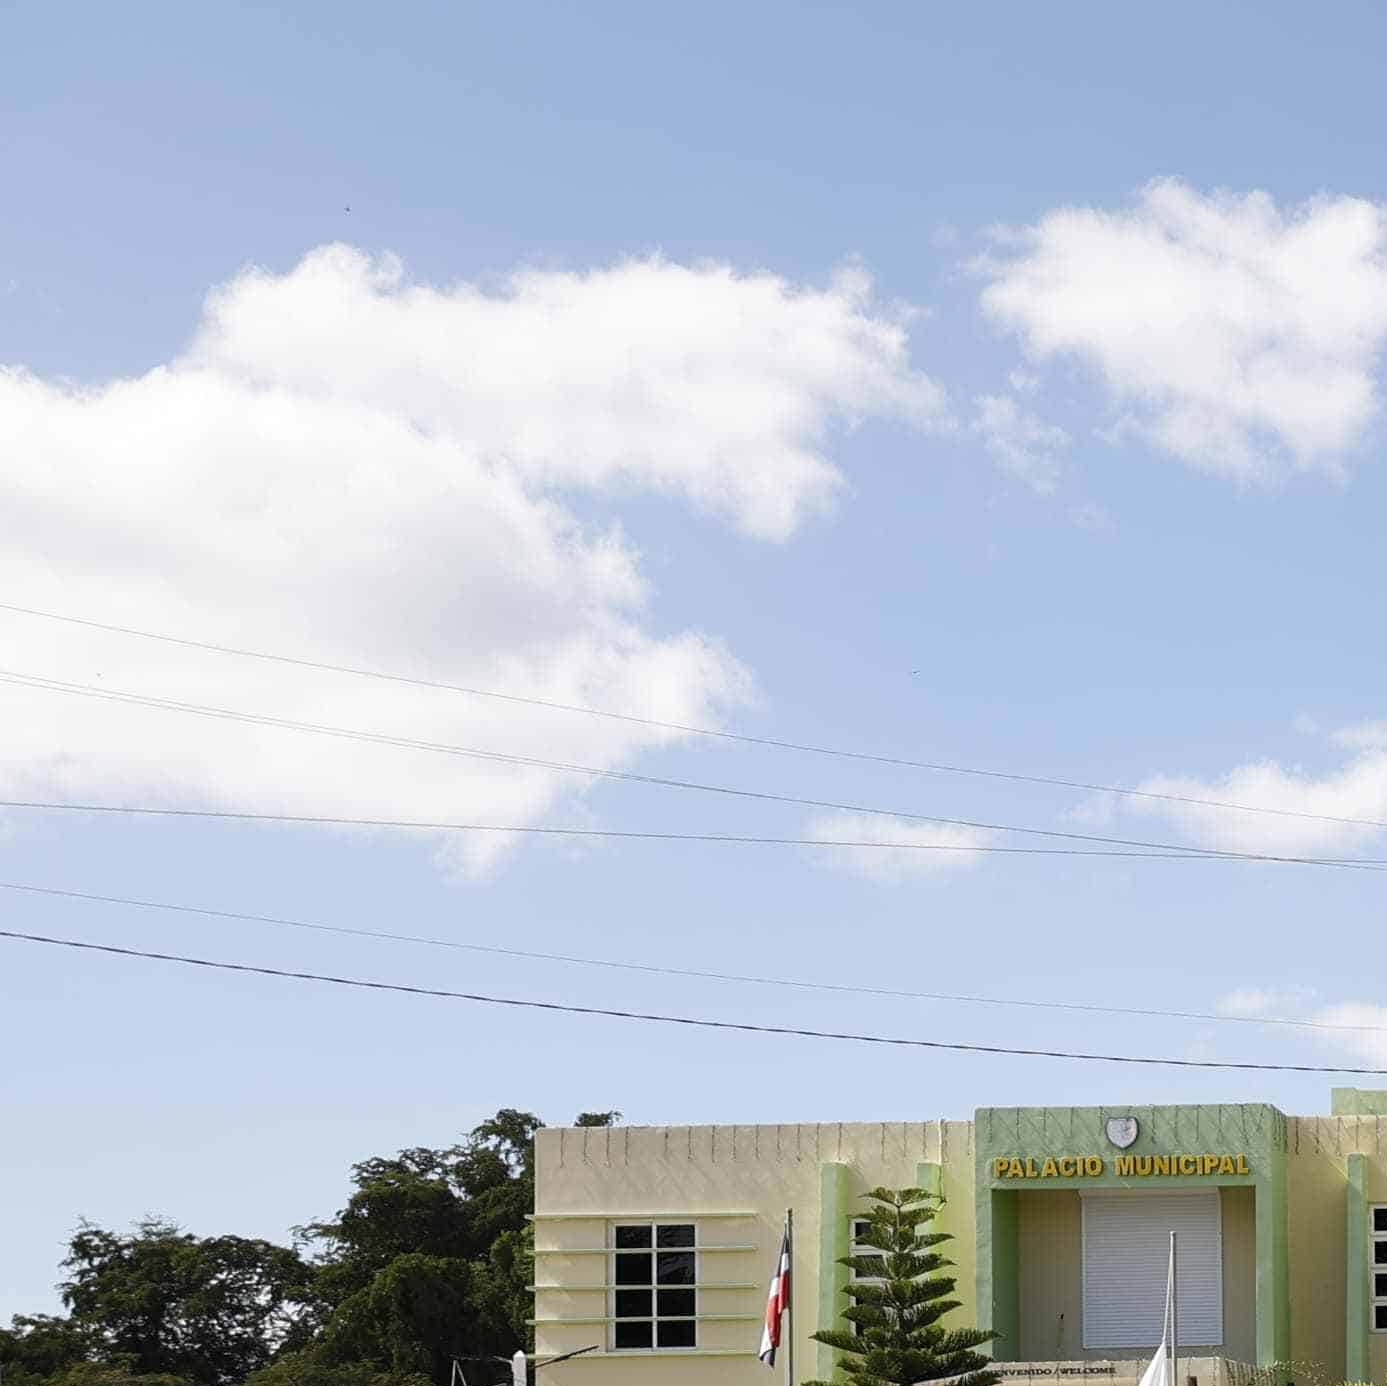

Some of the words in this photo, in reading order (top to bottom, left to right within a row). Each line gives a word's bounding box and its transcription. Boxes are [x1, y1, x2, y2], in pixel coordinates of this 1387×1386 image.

[992, 1154, 1105, 1178] PALACIO
[1113, 1152, 1250, 1177] MUNICIPAL
[1060, 1366, 1117, 1376] WELCOME
